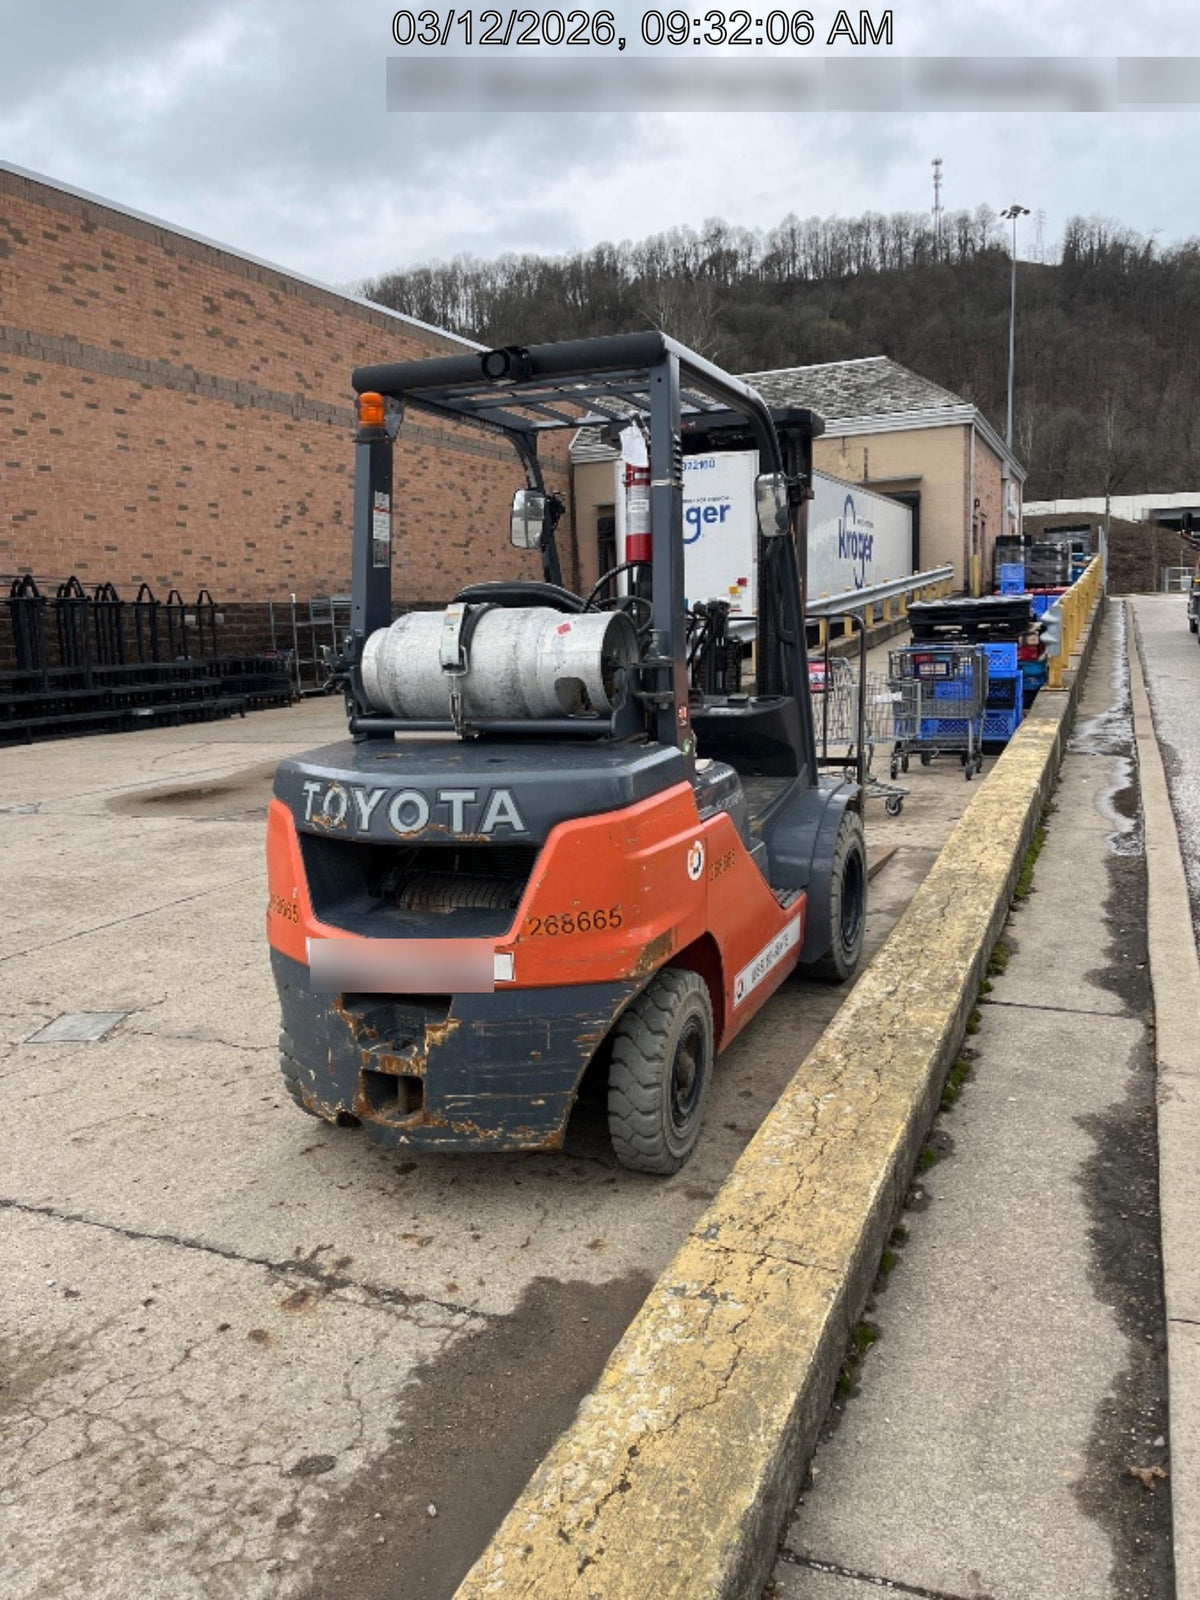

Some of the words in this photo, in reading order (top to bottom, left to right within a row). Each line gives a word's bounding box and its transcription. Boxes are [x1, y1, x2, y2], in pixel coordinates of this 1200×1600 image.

[683, 503, 731, 544] ger
[302, 780, 527, 833] TOYOTA
[529, 904, 623, 937] 268665
